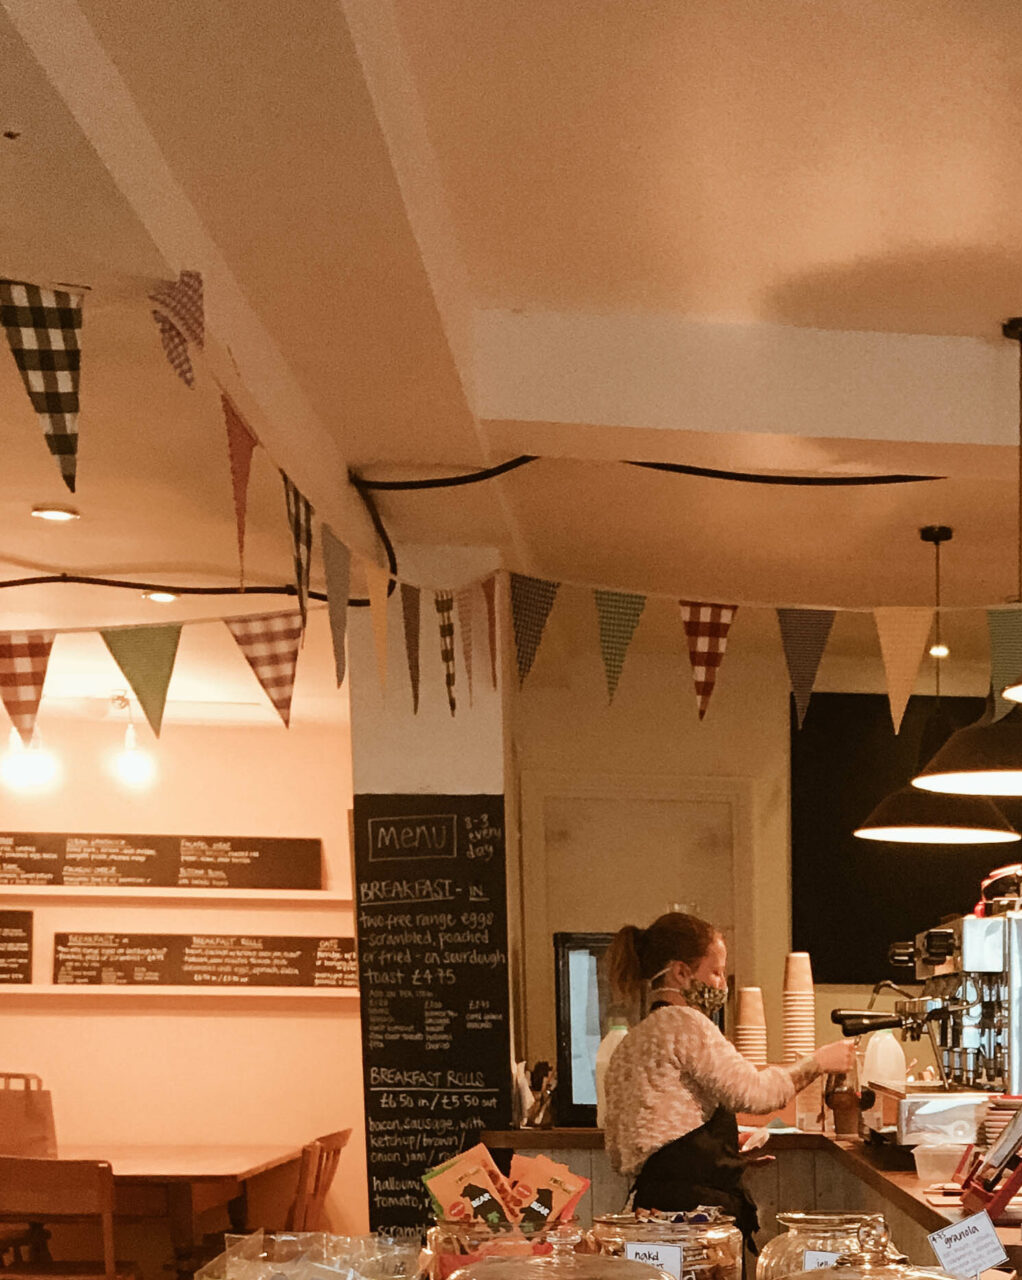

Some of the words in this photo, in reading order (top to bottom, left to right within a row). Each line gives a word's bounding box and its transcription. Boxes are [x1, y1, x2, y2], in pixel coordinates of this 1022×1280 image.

[468, 827, 501, 841] every
[466, 843, 494, 861] day
[360, 879, 453, 901] BREAKFAST
[469, 884, 484, 897] IN
[360, 910, 384, 928] two
[386, 912, 414, 929] free
[416, 912, 457, 930] range
[461, 911, 494, 929] eggs
[438, 929, 489, 949] poached
[362, 951, 377, 963] or
[378, 948, 411, 966] fried
[424, 952, 441, 964] on
[443, 949, 507, 968] sourdough
[363, 968, 405, 984] toast
[370, 1067, 442, 1087] BREAKFAST
[447, 1071, 486, 1087] ROLLS
[482, 1097, 498, 1108] out
[460, 1116, 487, 1130] with
[370, 1152, 401, 1162] onion
[471, 1192, 492, 1208] BEAR
[530, 1200, 551, 1216] BEAR
[944, 1225, 979, 1249] granola
[634, 1251, 659, 1261] nakd
